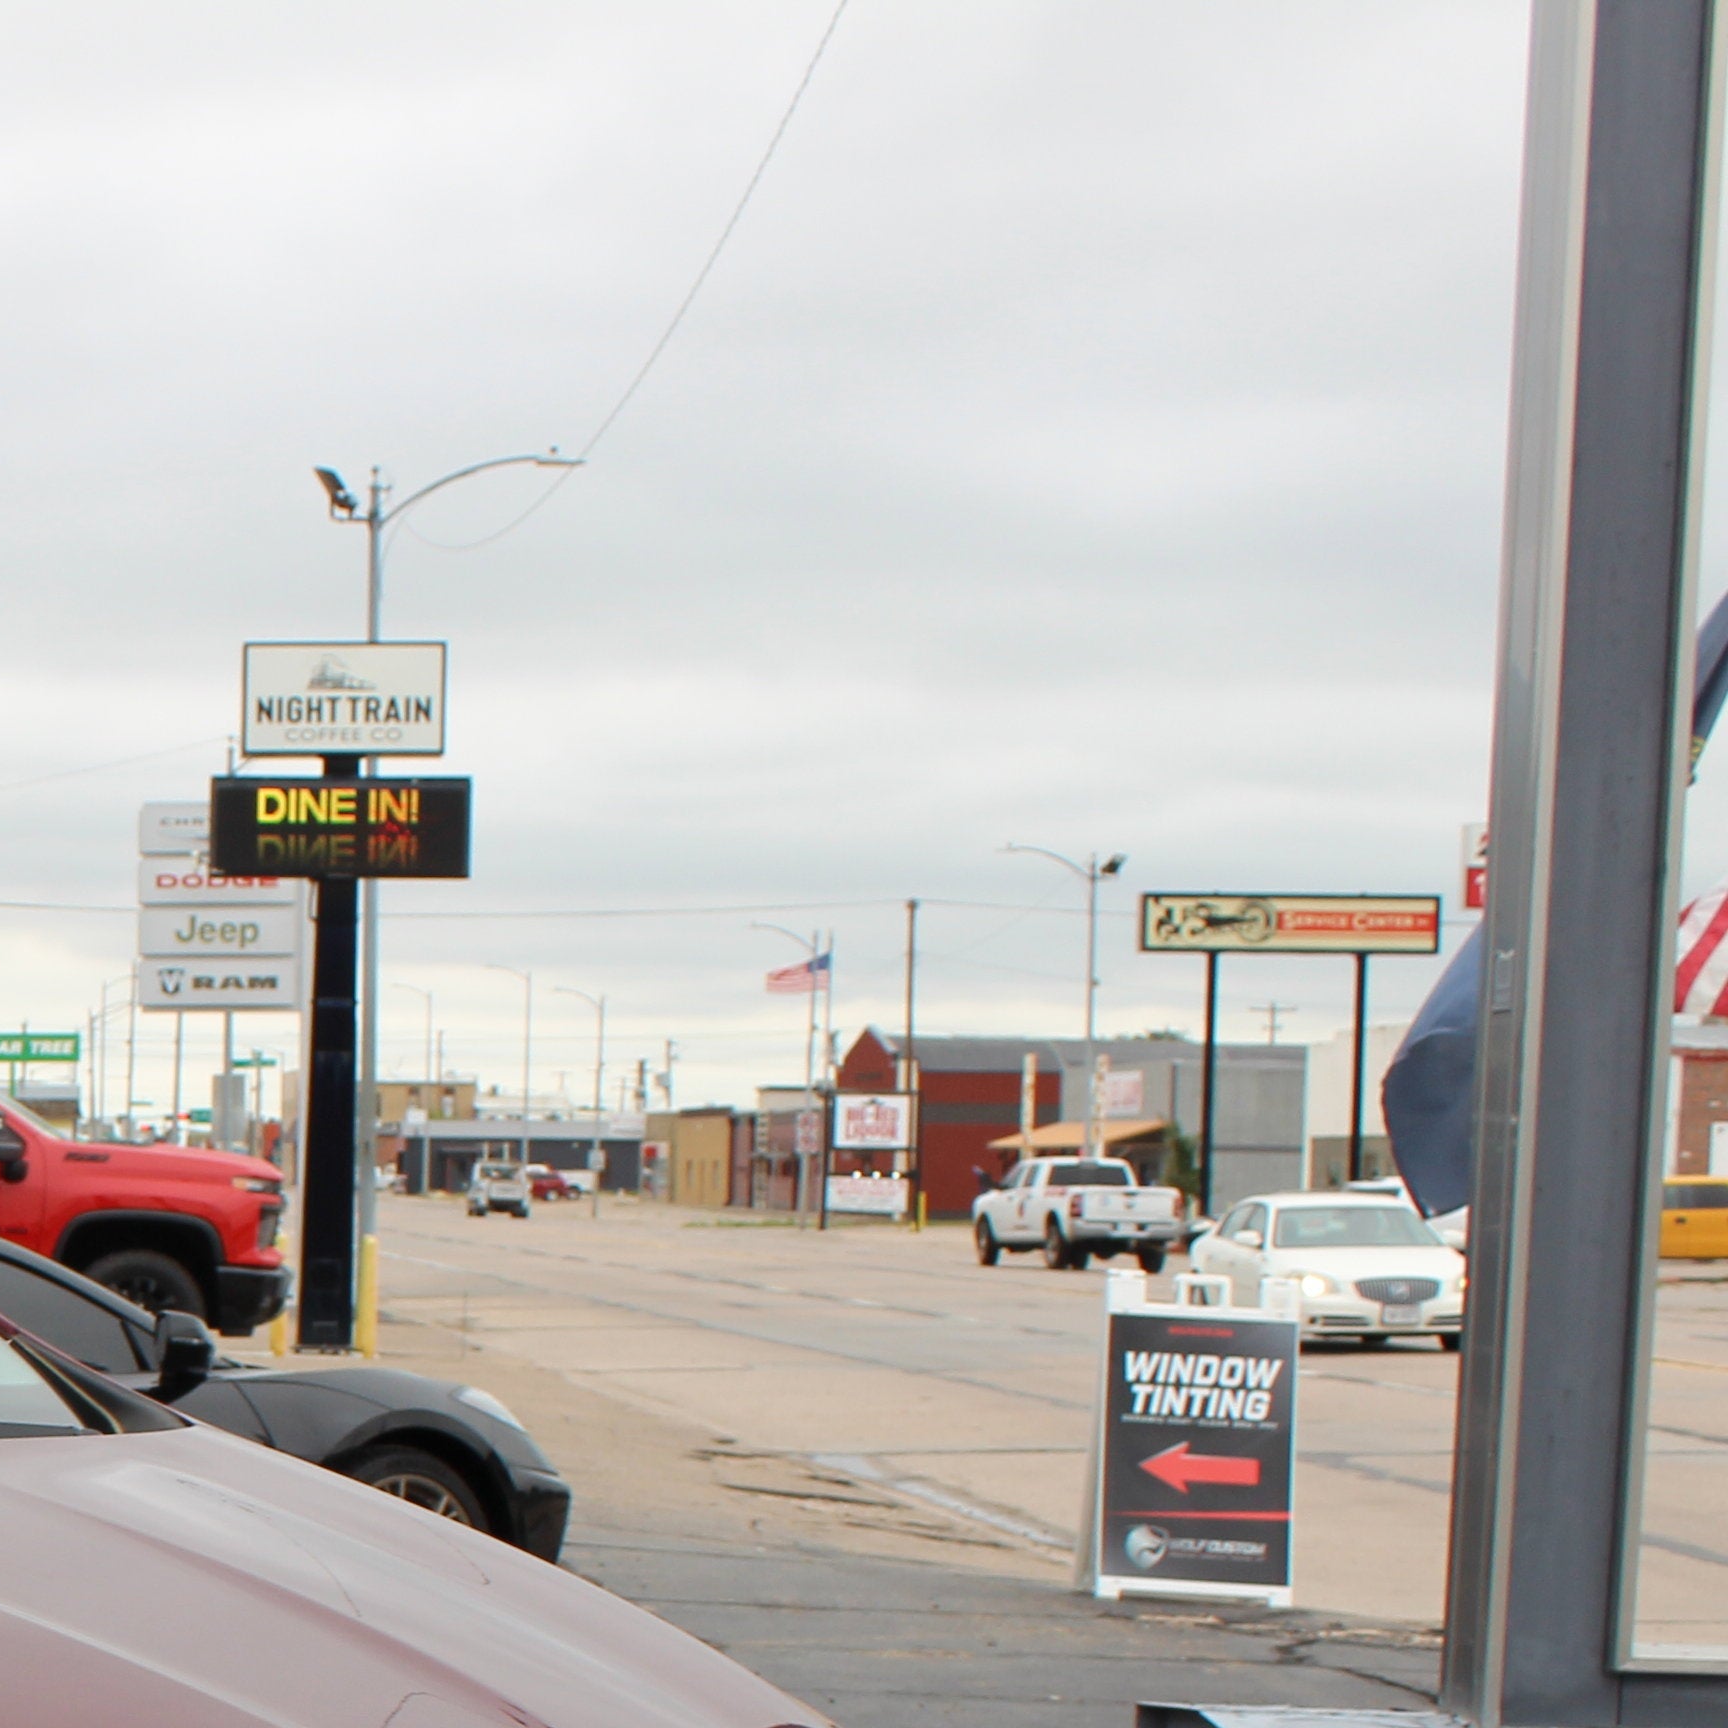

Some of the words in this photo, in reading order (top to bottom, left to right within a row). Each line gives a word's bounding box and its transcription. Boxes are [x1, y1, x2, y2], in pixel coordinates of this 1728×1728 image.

[256, 696, 342, 723] NIGHT
[347, 695, 433, 723] TRAIN
[284, 727, 362, 743] COFFEE
[369, 727, 403, 742] CO
[257, 787, 357, 825] DINE
[367, 788, 420, 825] IN!
[155, 873, 279, 889] DODGE
[175, 914, 260, 948] Jeep
[1352, 910, 1414, 929] CENTER
[191, 974, 279, 990] RAM
[30, 1040, 76, 1056] TREE
[1123, 1350, 1284, 1390] WINDOW
[1130, 1383, 1273, 1422] TINTING
